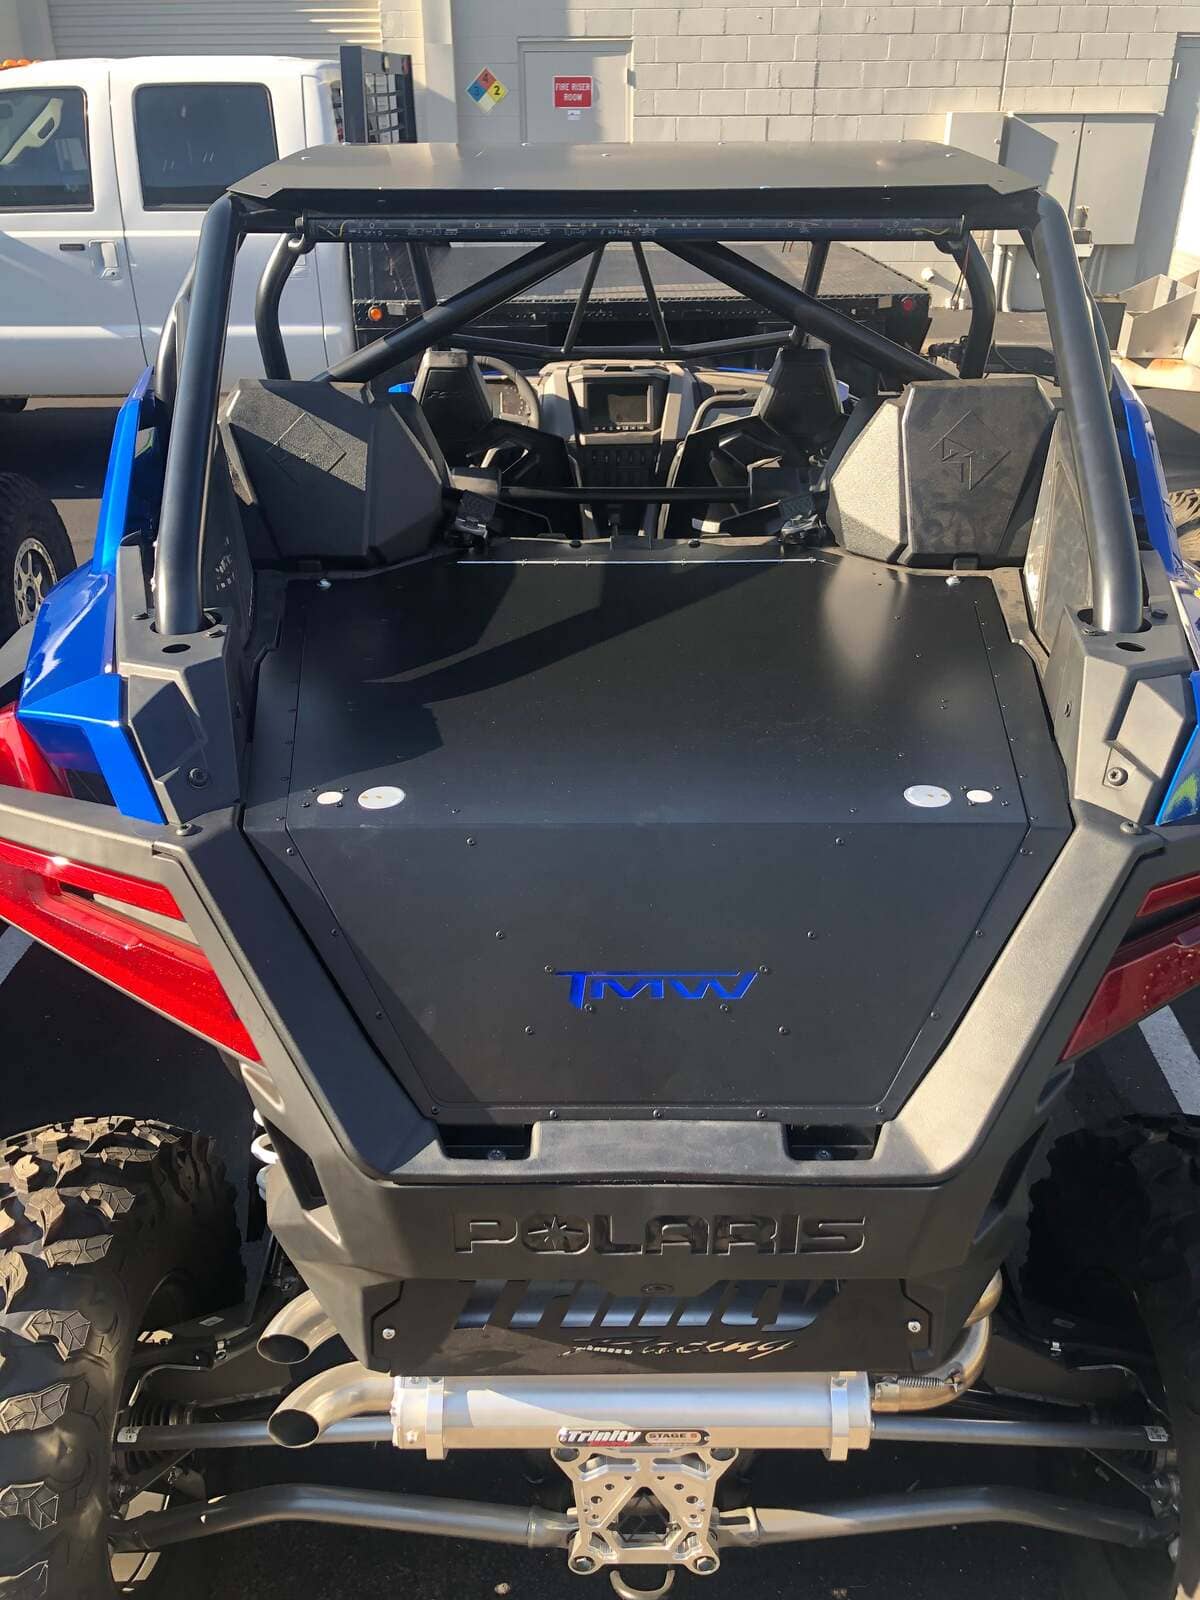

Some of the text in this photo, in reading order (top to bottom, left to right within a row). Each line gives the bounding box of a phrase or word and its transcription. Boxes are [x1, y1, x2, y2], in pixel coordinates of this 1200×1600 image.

[482, 73, 489, 82] 4
[494, 85, 501, 96] 2
[556, 82, 590, 91] FIRE RISER
[564, 93, 582, 101] ROOM
[555, 970, 758, 1009] TMW
[453, 1213, 866, 1256] POLARIS
